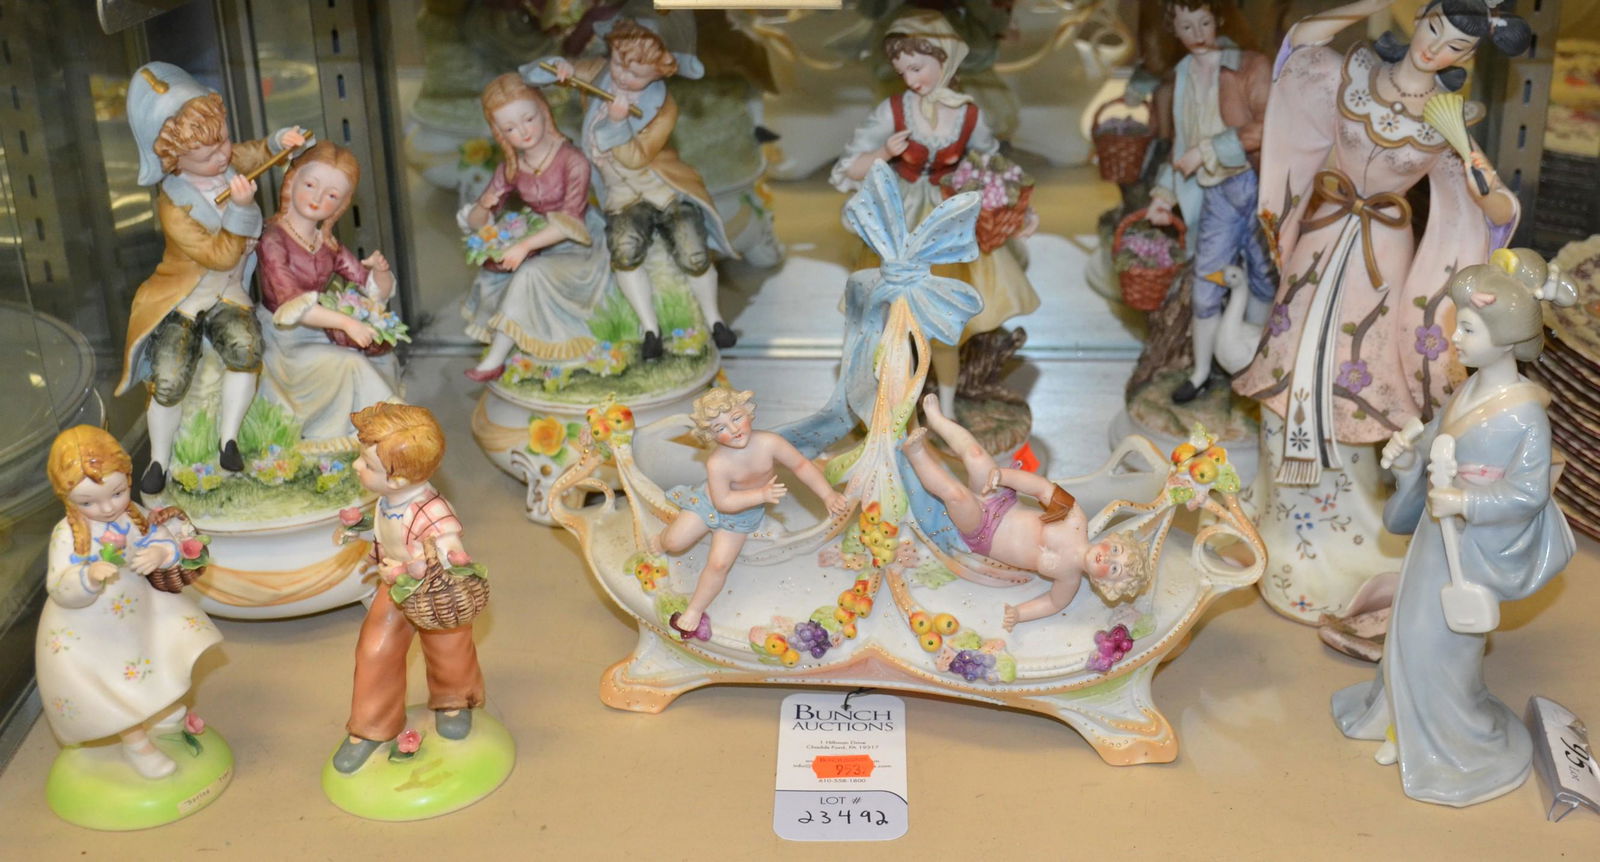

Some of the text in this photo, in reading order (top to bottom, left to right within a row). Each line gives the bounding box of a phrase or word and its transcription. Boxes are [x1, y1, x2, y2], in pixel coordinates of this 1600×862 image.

[795, 704, 891, 721] BUNCH
[792, 721, 894, 732] AUCTIONS
[820, 796, 861, 805] LOT #
[798, 810, 888, 826] 23492
